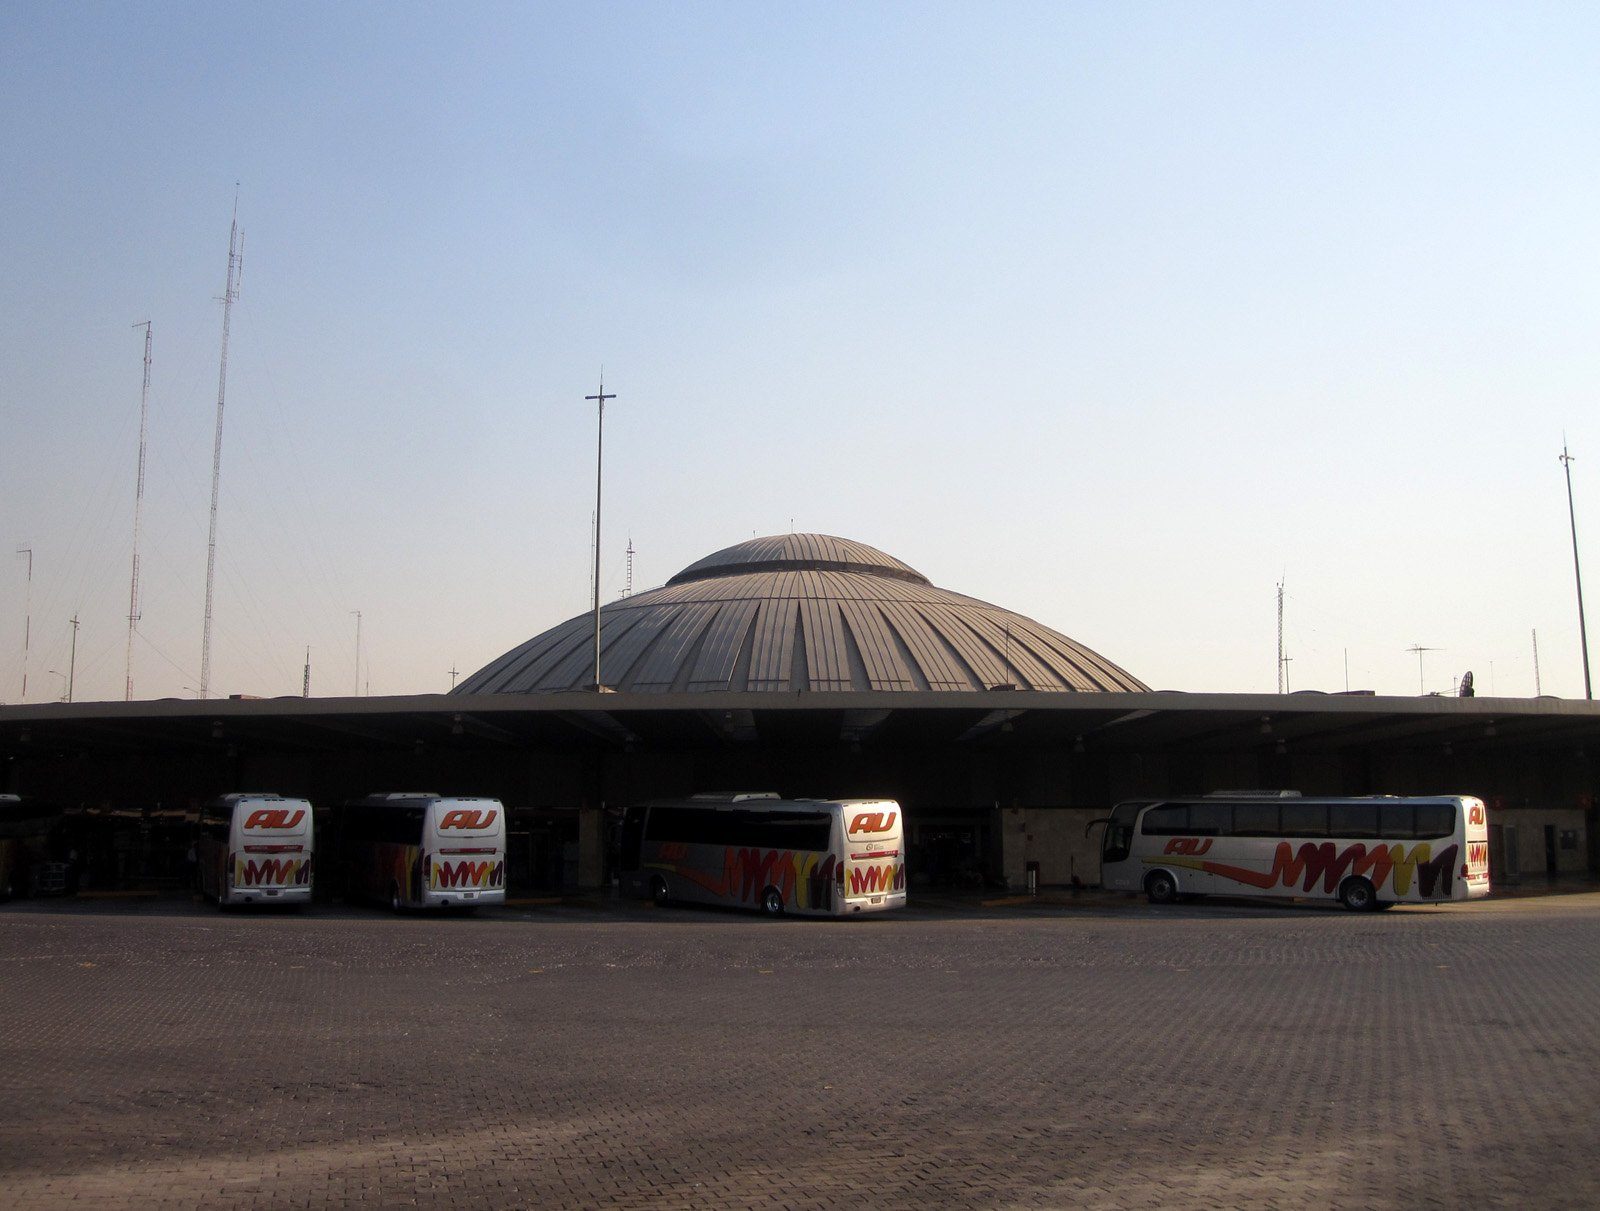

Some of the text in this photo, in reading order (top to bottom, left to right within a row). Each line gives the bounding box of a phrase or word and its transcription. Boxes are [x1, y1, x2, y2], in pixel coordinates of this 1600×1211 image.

[244, 810, 306, 829] AU
[440, 810, 498, 829] AU
[849, 812, 897, 834] AU
[1163, 838, 1214, 856] AU
